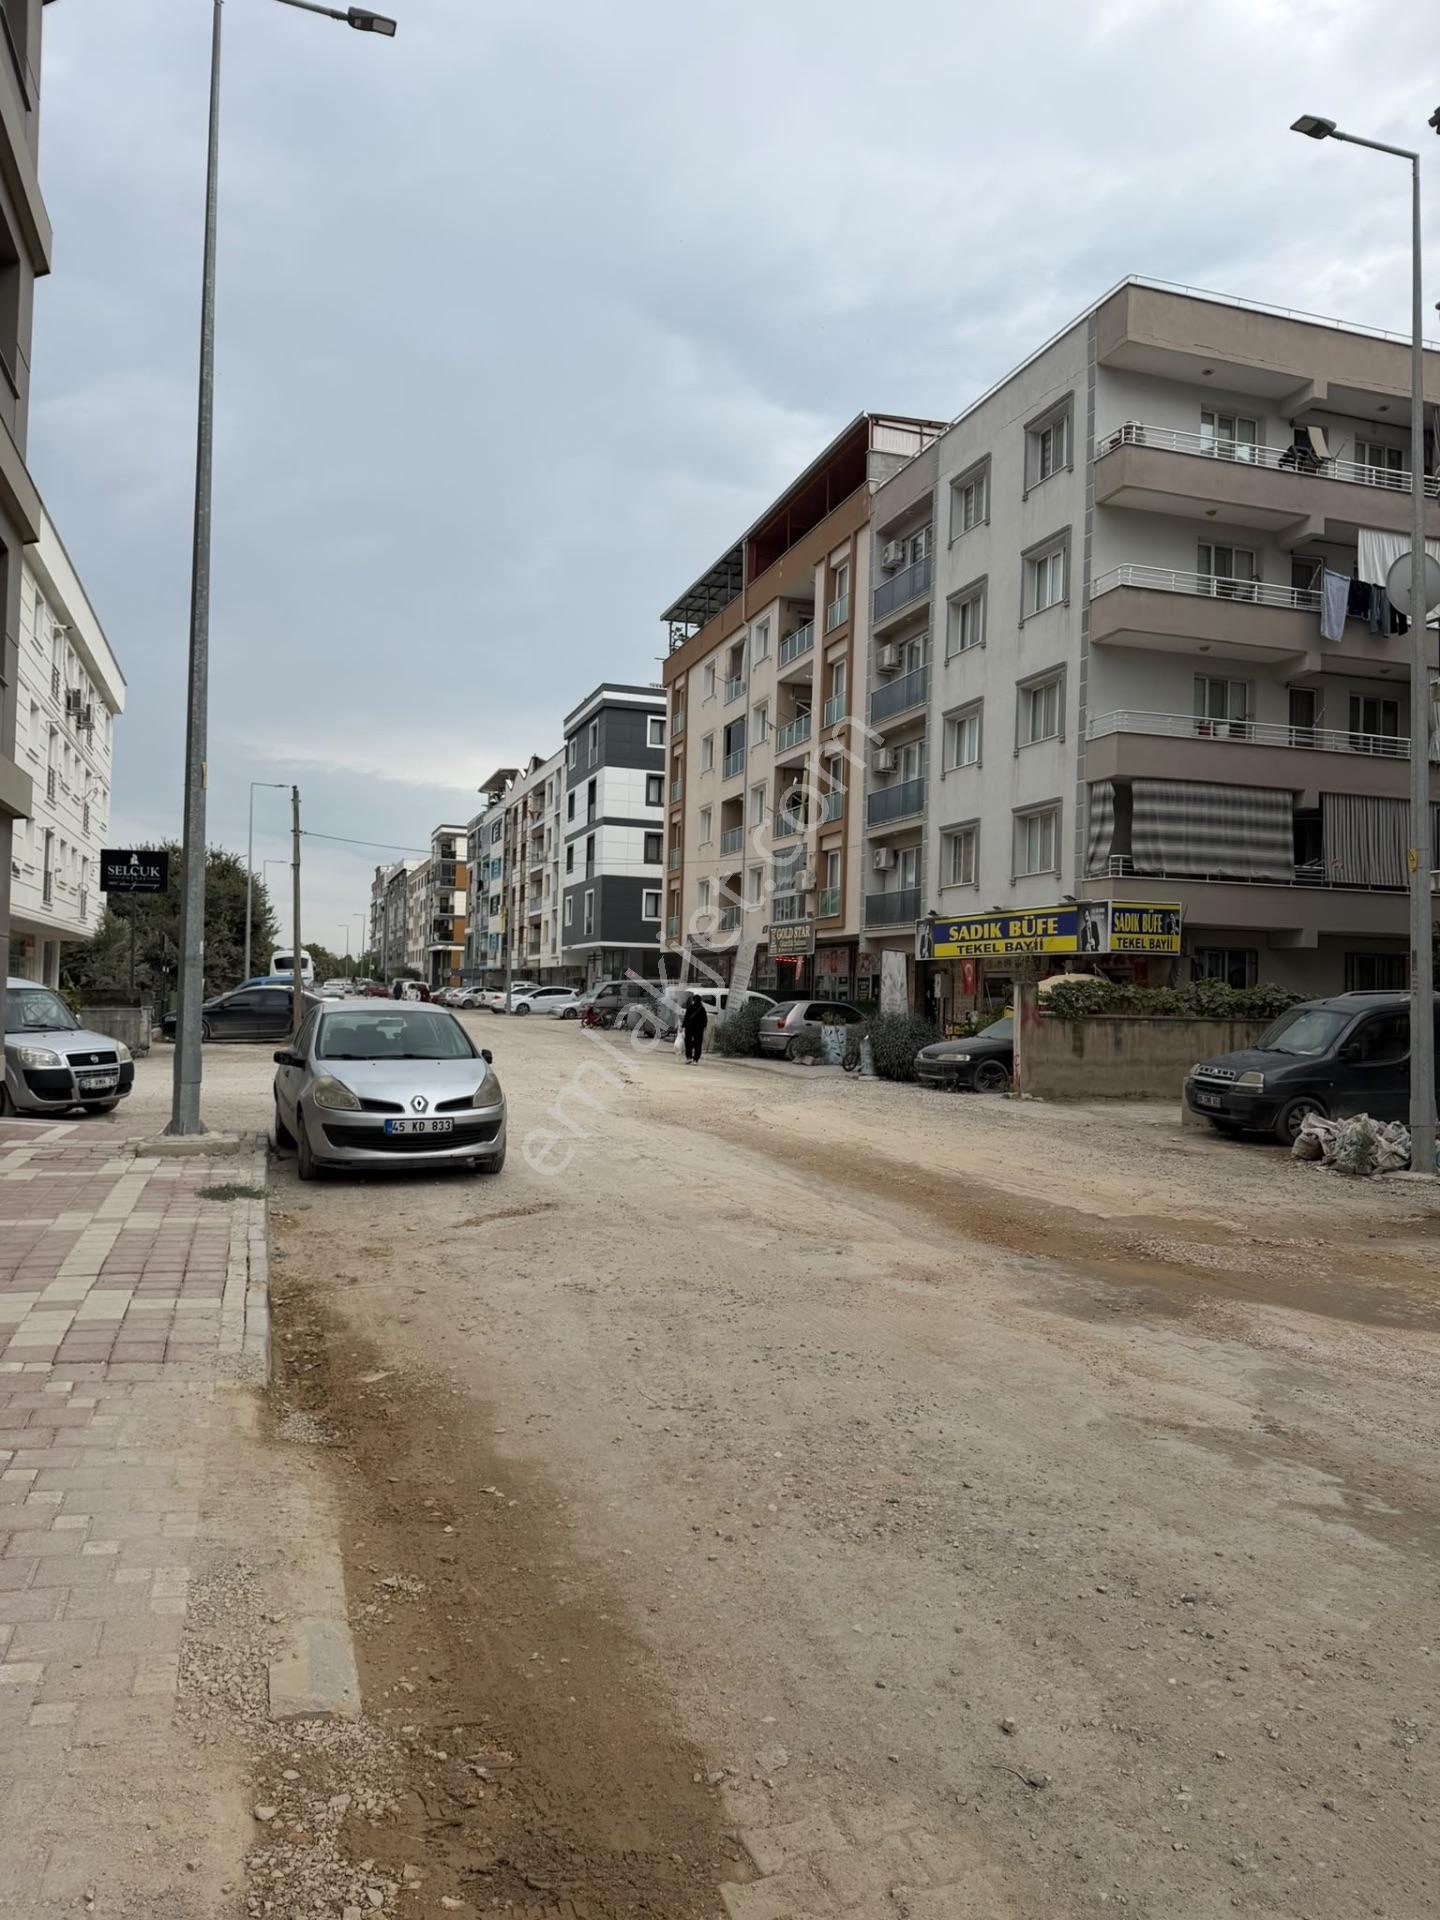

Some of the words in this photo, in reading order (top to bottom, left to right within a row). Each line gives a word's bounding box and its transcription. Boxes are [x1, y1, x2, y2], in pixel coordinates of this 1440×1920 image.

[1113, 912, 1140, 932] SADIK
[1142, 909, 1163, 933] BÜFE
[948, 922, 1002, 941] SADIK
[1008, 915, 1059, 938] BÜFE
[957, 943, 1000, 955] TEKEL
[1117, 937, 1146, 949] TEKEL
[392, 1121, 405, 1132] 45
[412, 1121, 425, 1132] KD
[432, 1120, 451, 1131] 833
